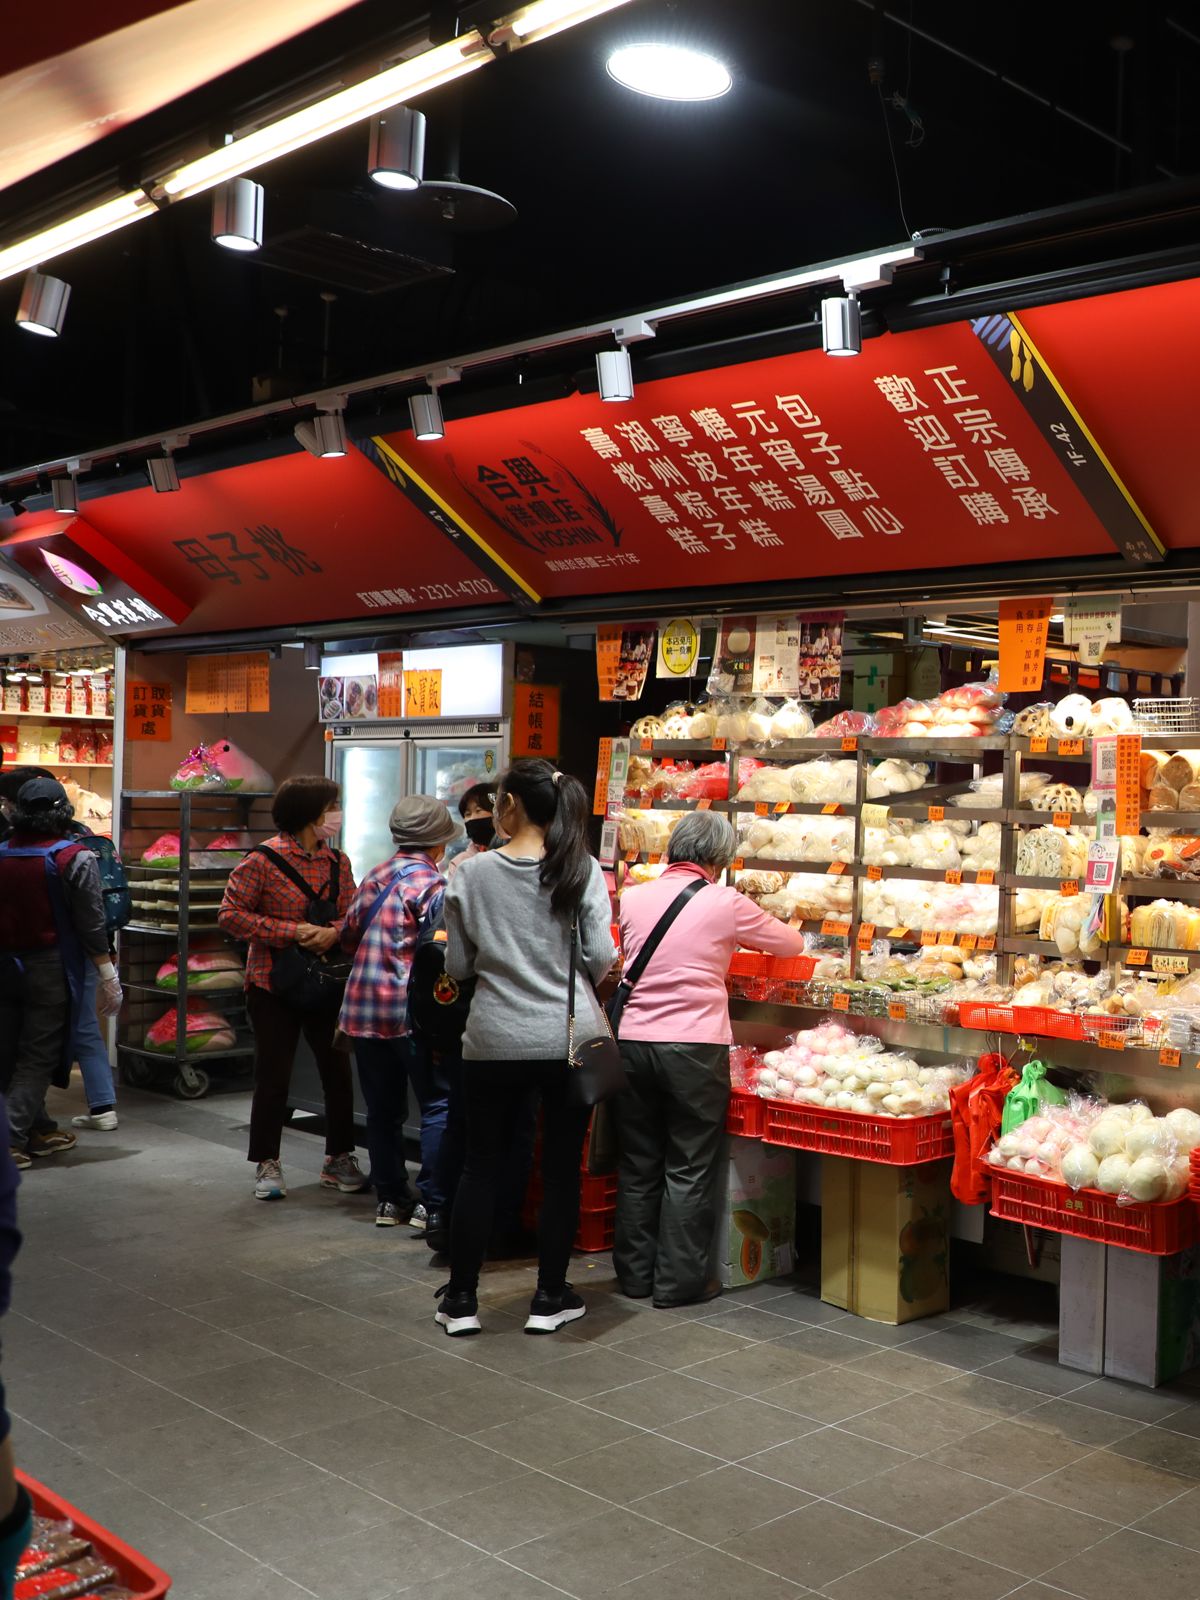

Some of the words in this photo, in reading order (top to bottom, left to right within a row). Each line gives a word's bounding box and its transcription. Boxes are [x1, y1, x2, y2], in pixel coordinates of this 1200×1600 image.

[690, 408, 796, 513] 糖年糕
[731, 401, 863, 540] 元宵湯圓
[776, 394, 904, 536] 包子點心
[873, 374, 1010, 526] 歡迎訂購
[925, 365, 1059, 520] 正宗傳承
[1048, 422, 1087, 467] 1F-42
[477, 456, 560, 500] 合興
[579, 427, 711, 555] 壽桃壽糕
[614, 421, 738, 552] 湖州粽子
[651, 414, 784, 549] 寧波年糕
[172, 524, 324, 585] 母子桃
[429, 510, 460, 540] 1F-41
[532, 526, 604, 548] HOSHIN
[545, 552, 641, 572] 創始於民國三十六年
[141, 721, 156, 736] 處
[150, 686, 166, 718] 取貨
[527, 691, 545, 751] 結帳處
